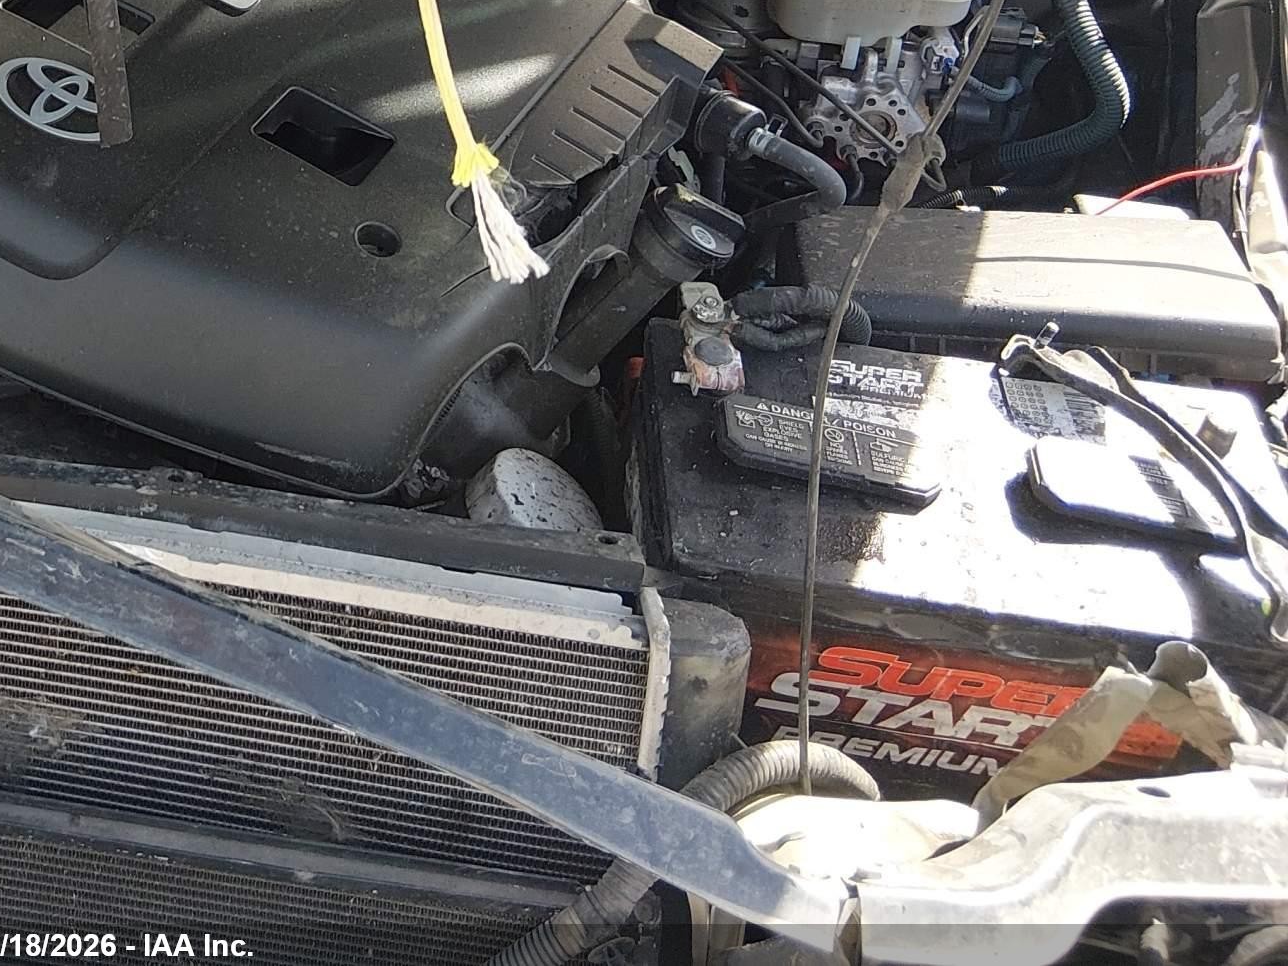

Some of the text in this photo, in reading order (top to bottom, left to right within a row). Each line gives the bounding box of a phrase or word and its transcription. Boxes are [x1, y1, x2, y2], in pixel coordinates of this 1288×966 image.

[829, 359, 922, 383] SUPER
[843, 420, 897, 439] POISON
[755, 672, 1058, 747] STAR
